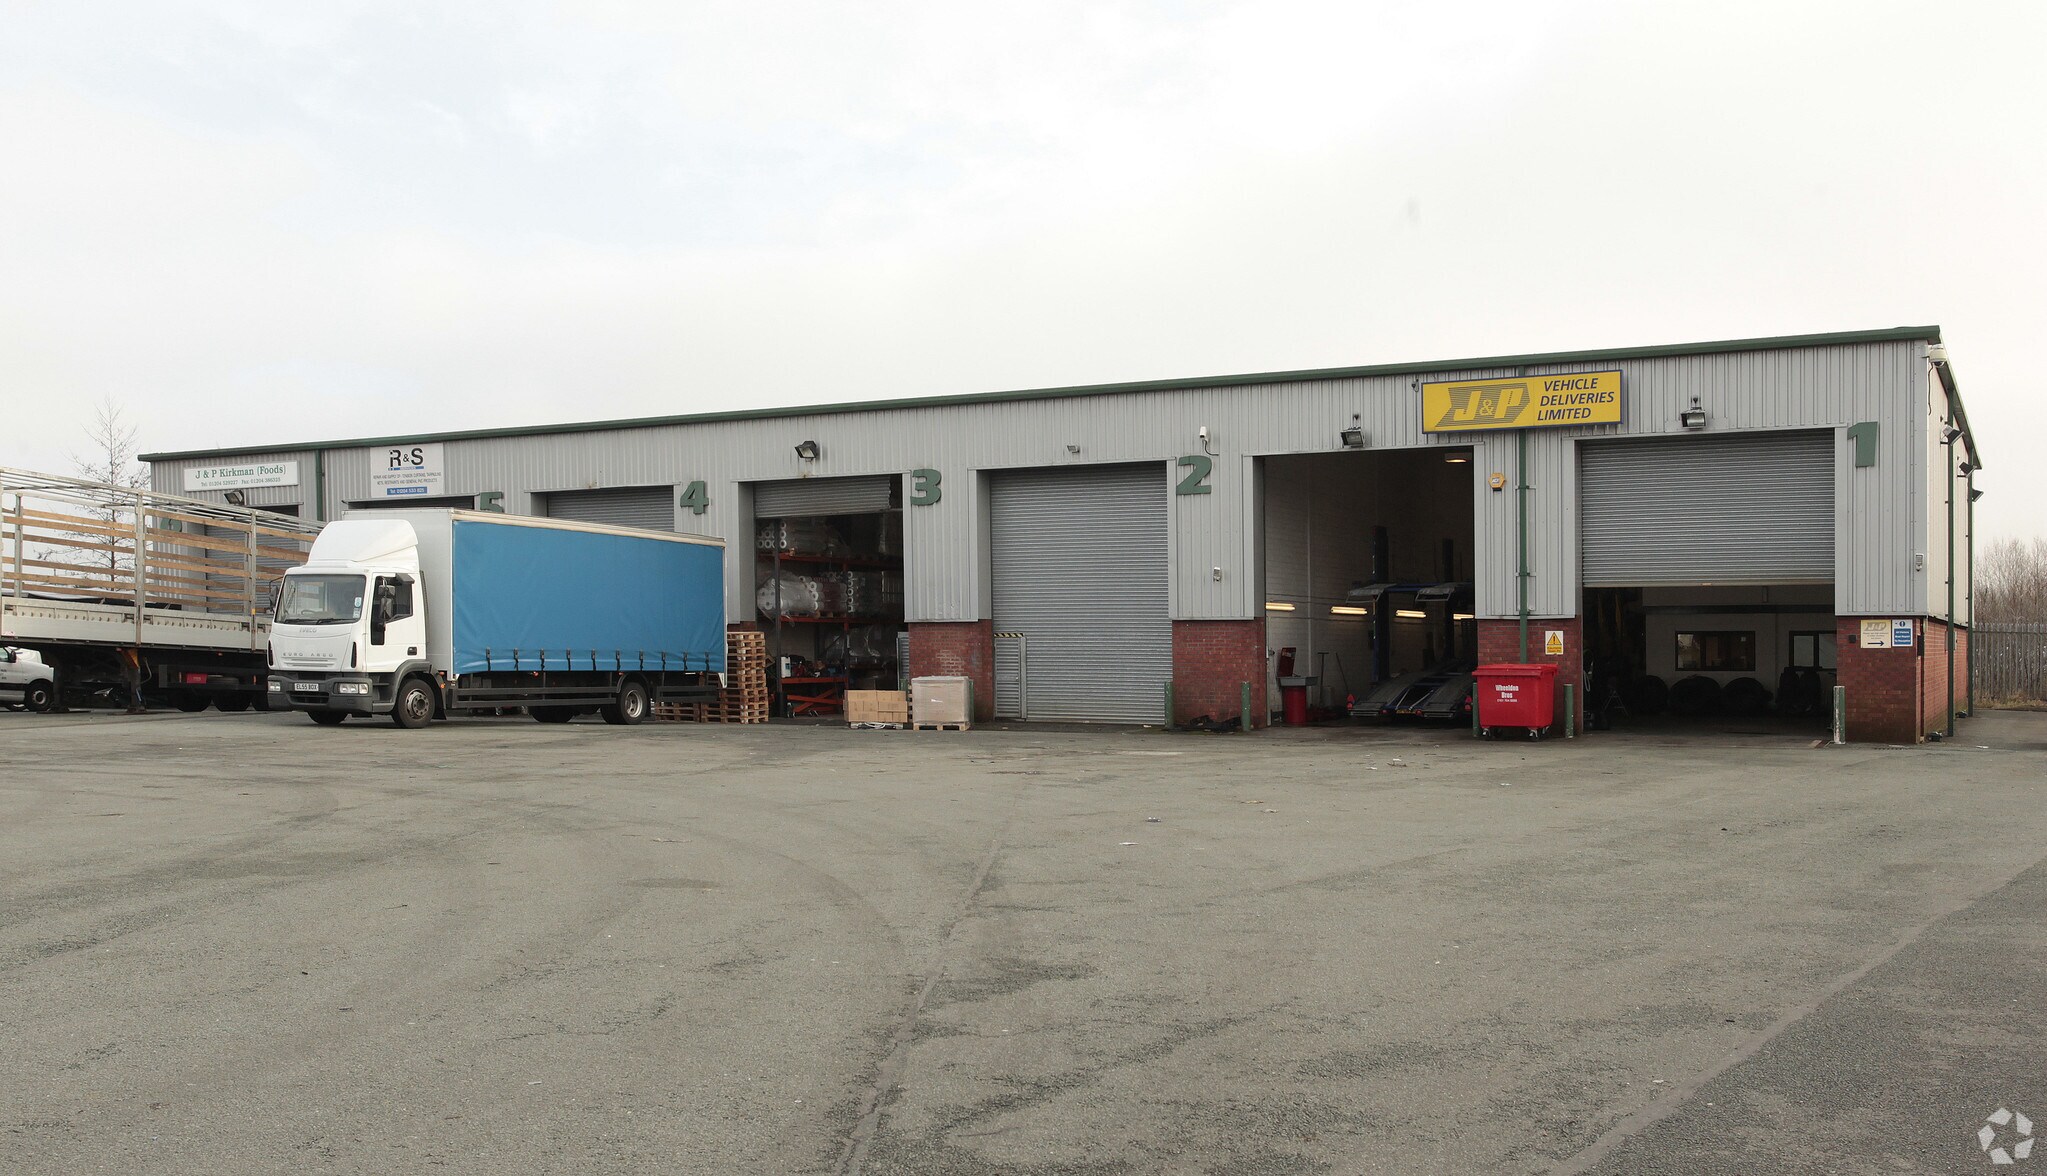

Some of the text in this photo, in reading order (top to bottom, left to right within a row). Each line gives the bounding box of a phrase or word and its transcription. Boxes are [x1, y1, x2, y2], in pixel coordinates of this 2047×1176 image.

[1544, 378, 1598, 392] VEHICLE
[1453, 388, 1523, 421] J&P
[1540, 391, 1614, 407] DELIVERIES
[1537, 407, 1591, 421] LIMITED
[1847, 421, 1878, 468] 1
[195, 464, 286, 479] J & P Kirkman (Foods)
[1176, 455, 1212, 495] 2
[680, 480, 709, 515] 4
[910, 468, 942, 506] 3
[480, 491, 504, 513] 5
